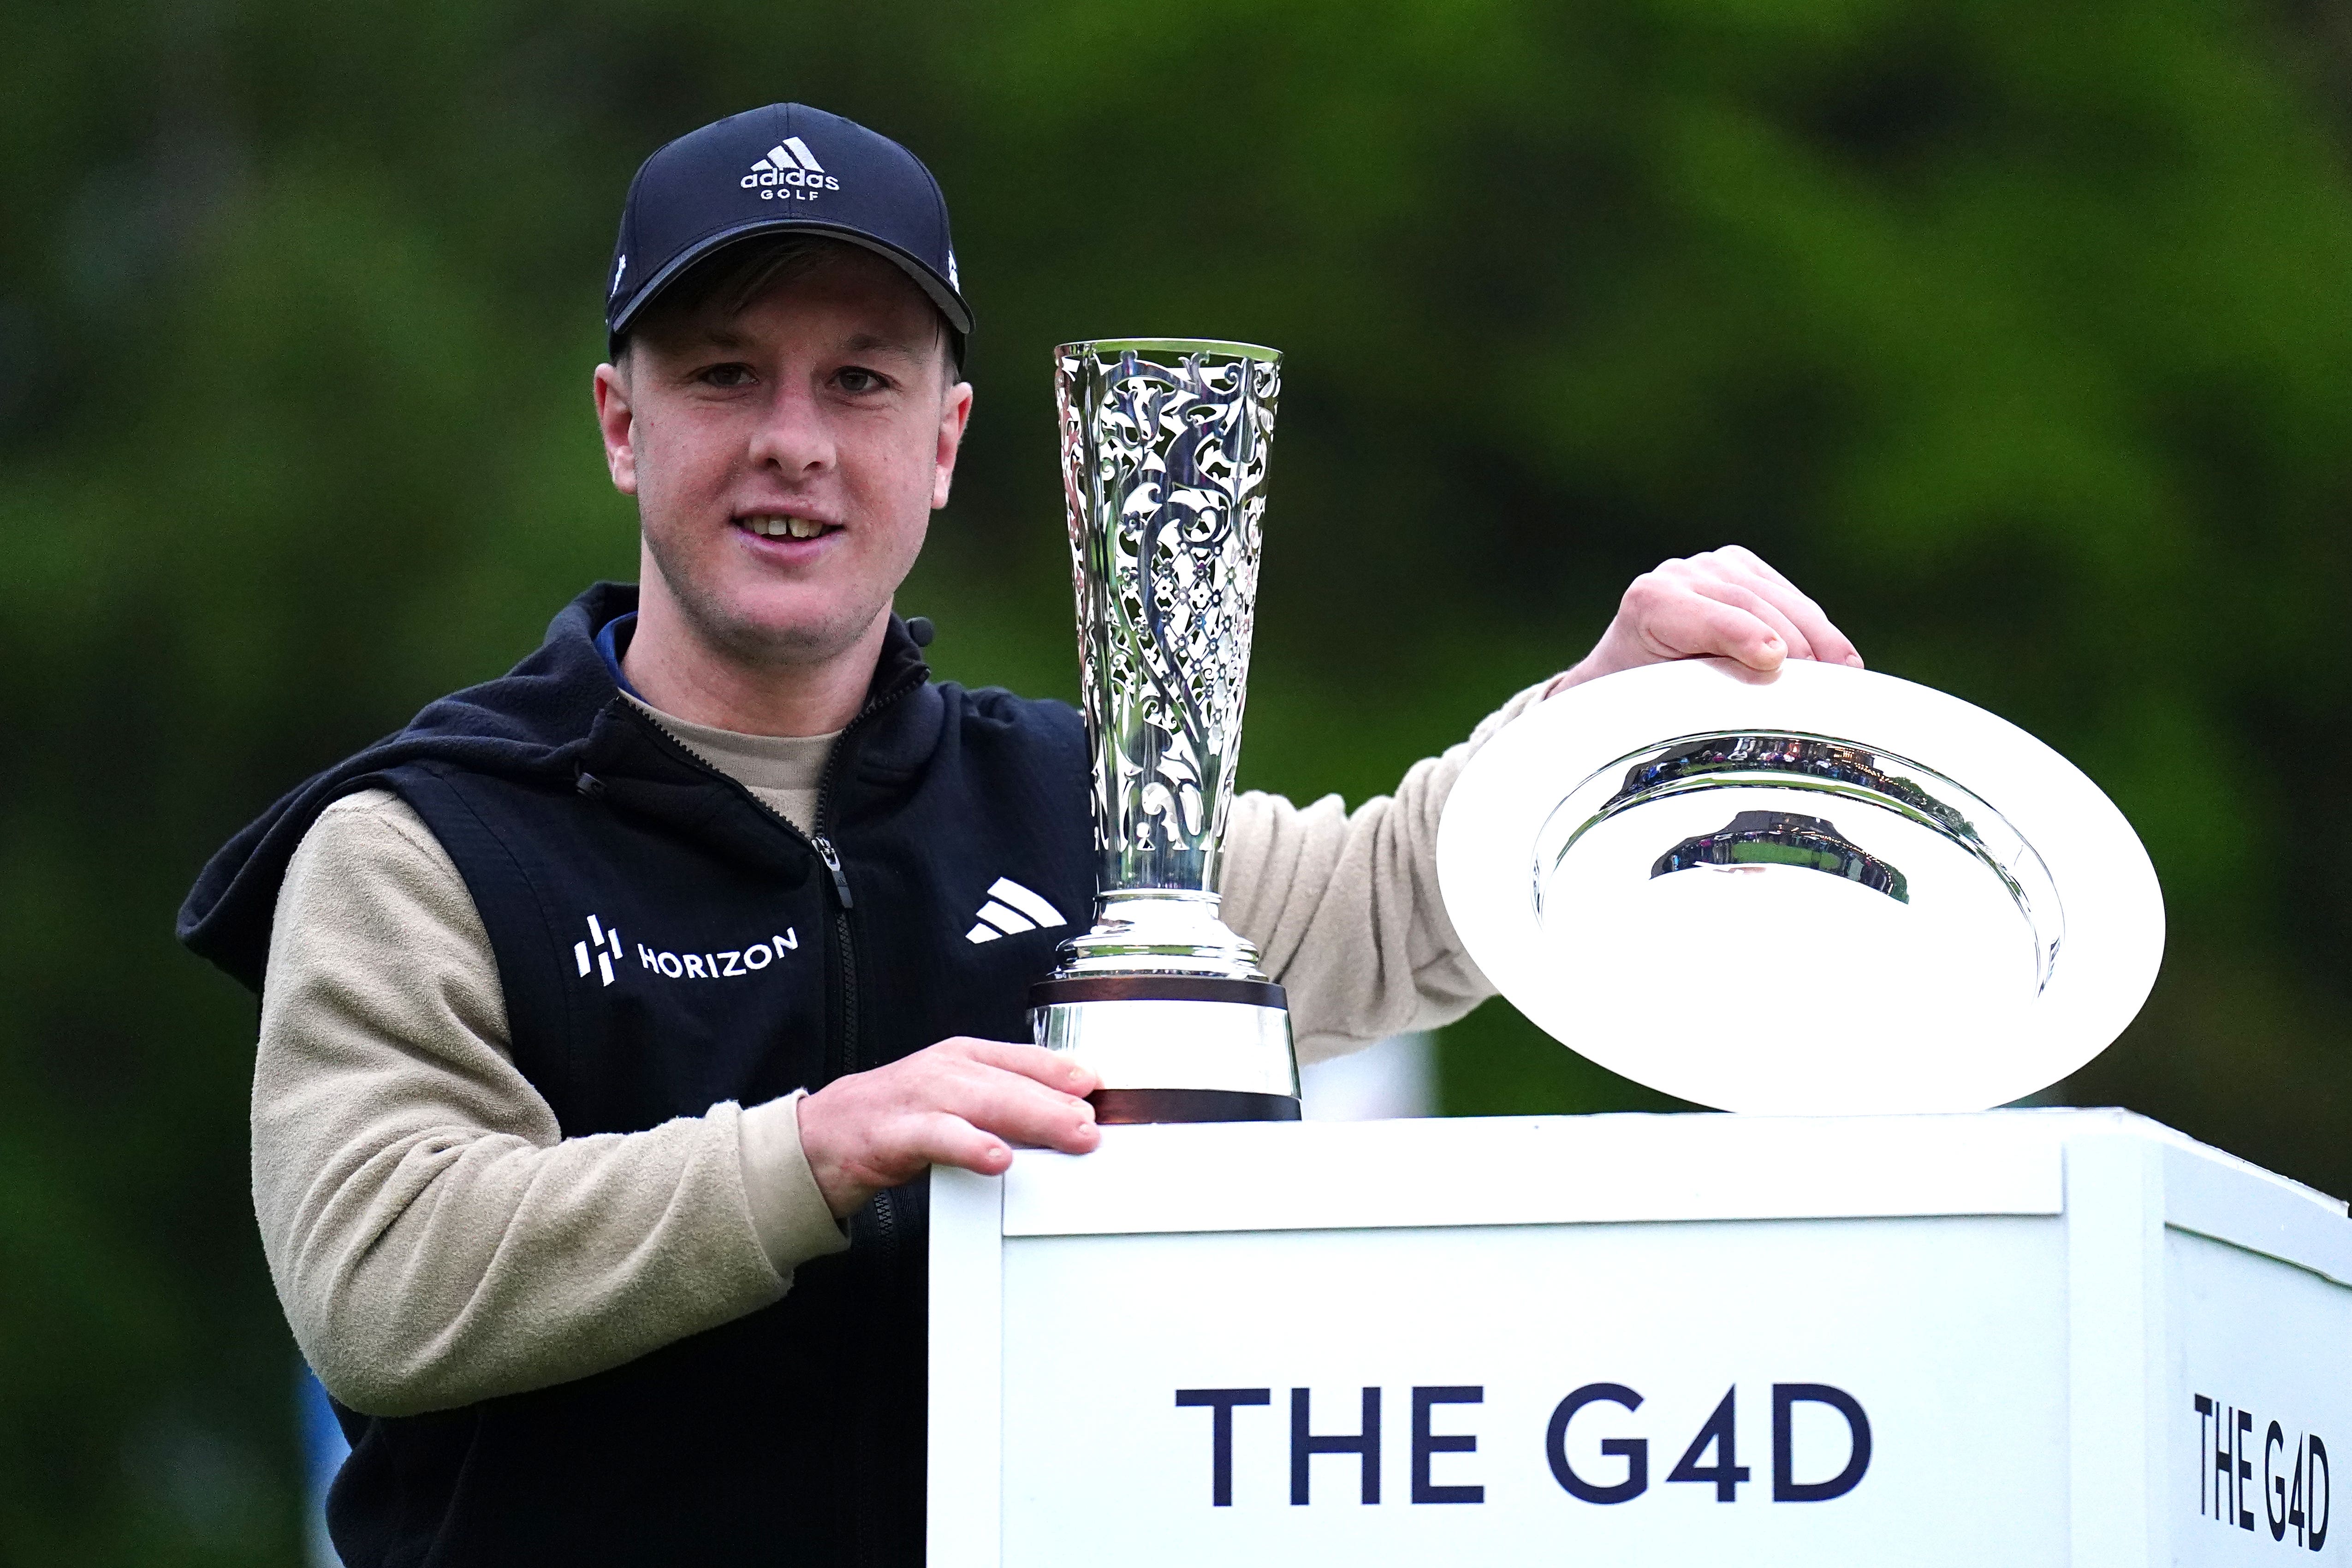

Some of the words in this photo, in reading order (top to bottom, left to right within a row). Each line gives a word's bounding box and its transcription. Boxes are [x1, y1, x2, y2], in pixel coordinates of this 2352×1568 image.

[740, 167, 840, 190] adidas
[760, 188, 819, 201] GOLF
[637, 927, 799, 979] HORIZON
[1176, 1385, 1485, 1507] THE
[1546, 1382, 1872, 1505] G4D
[2194, 1393, 2255, 1532] THE
[2265, 1420, 2330, 1552] G4D
